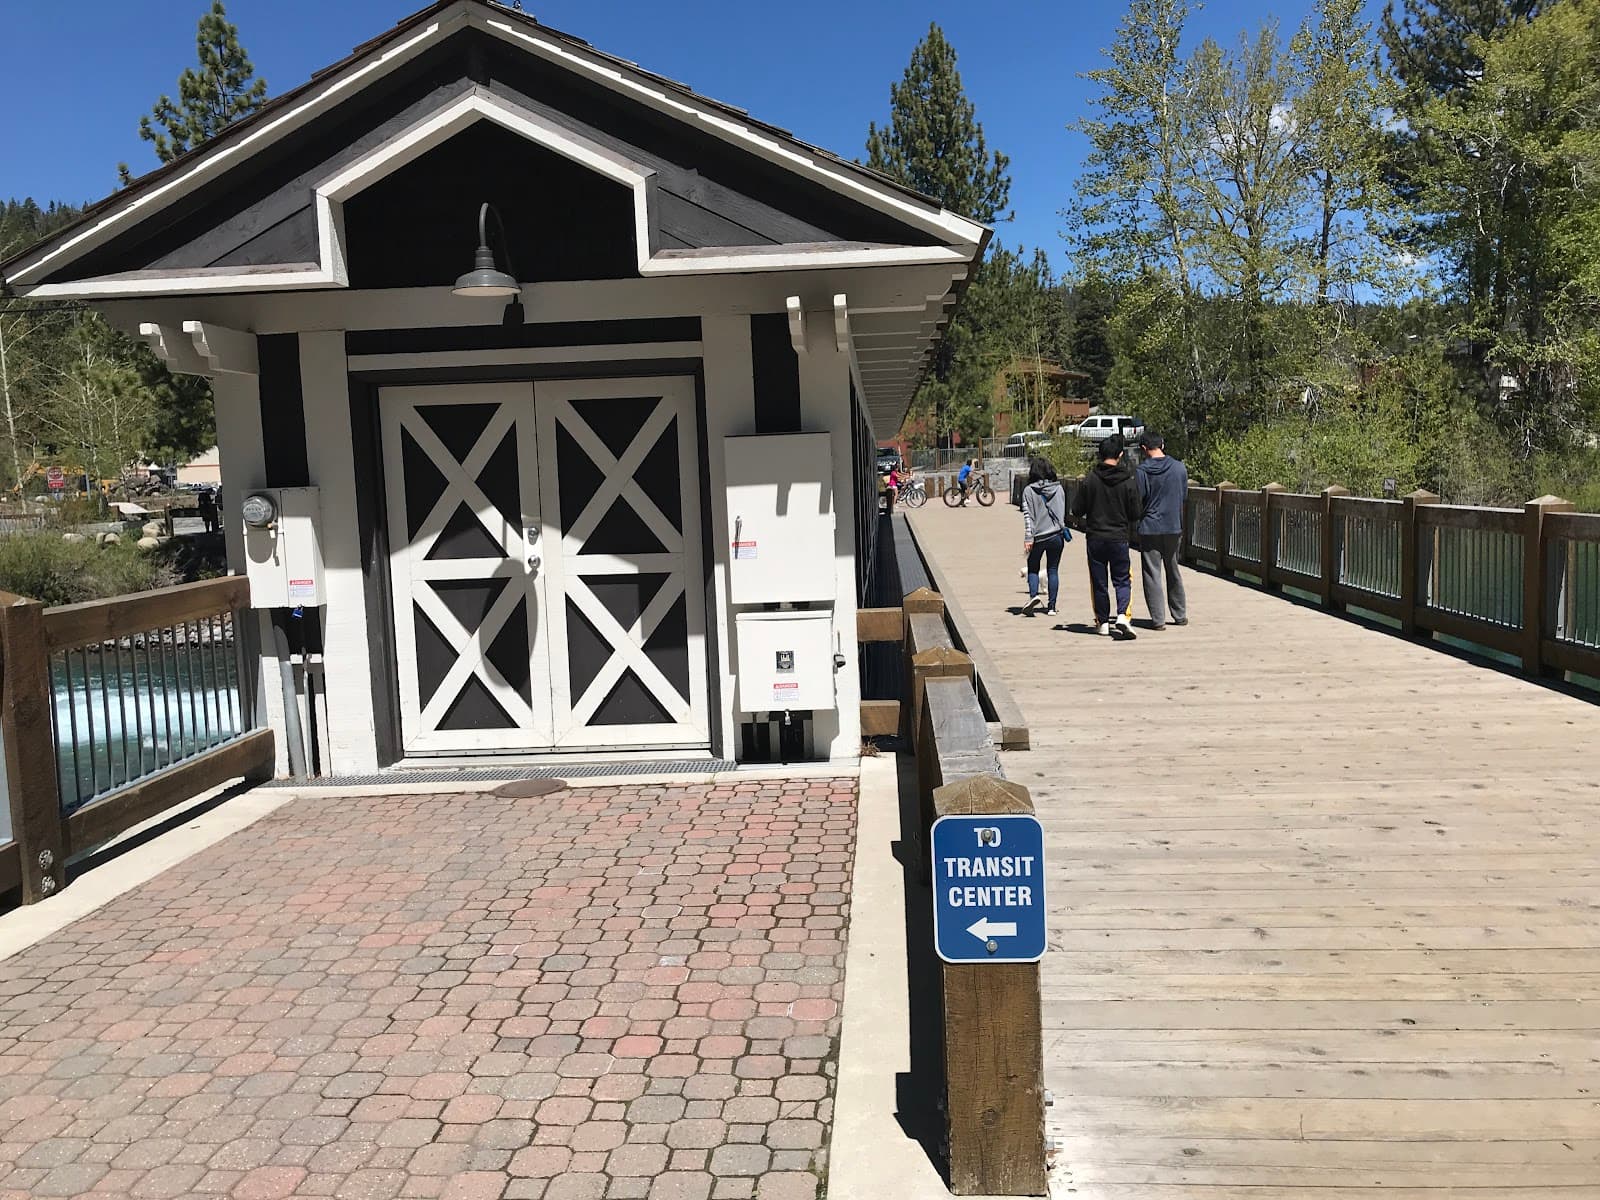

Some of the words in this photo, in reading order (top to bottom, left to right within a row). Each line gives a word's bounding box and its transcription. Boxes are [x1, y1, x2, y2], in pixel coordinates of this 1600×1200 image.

[974, 826, 1002, 848] TO
[943, 856, 1035, 878] TRANSIT
[948, 886, 1033, 907] CENTER
